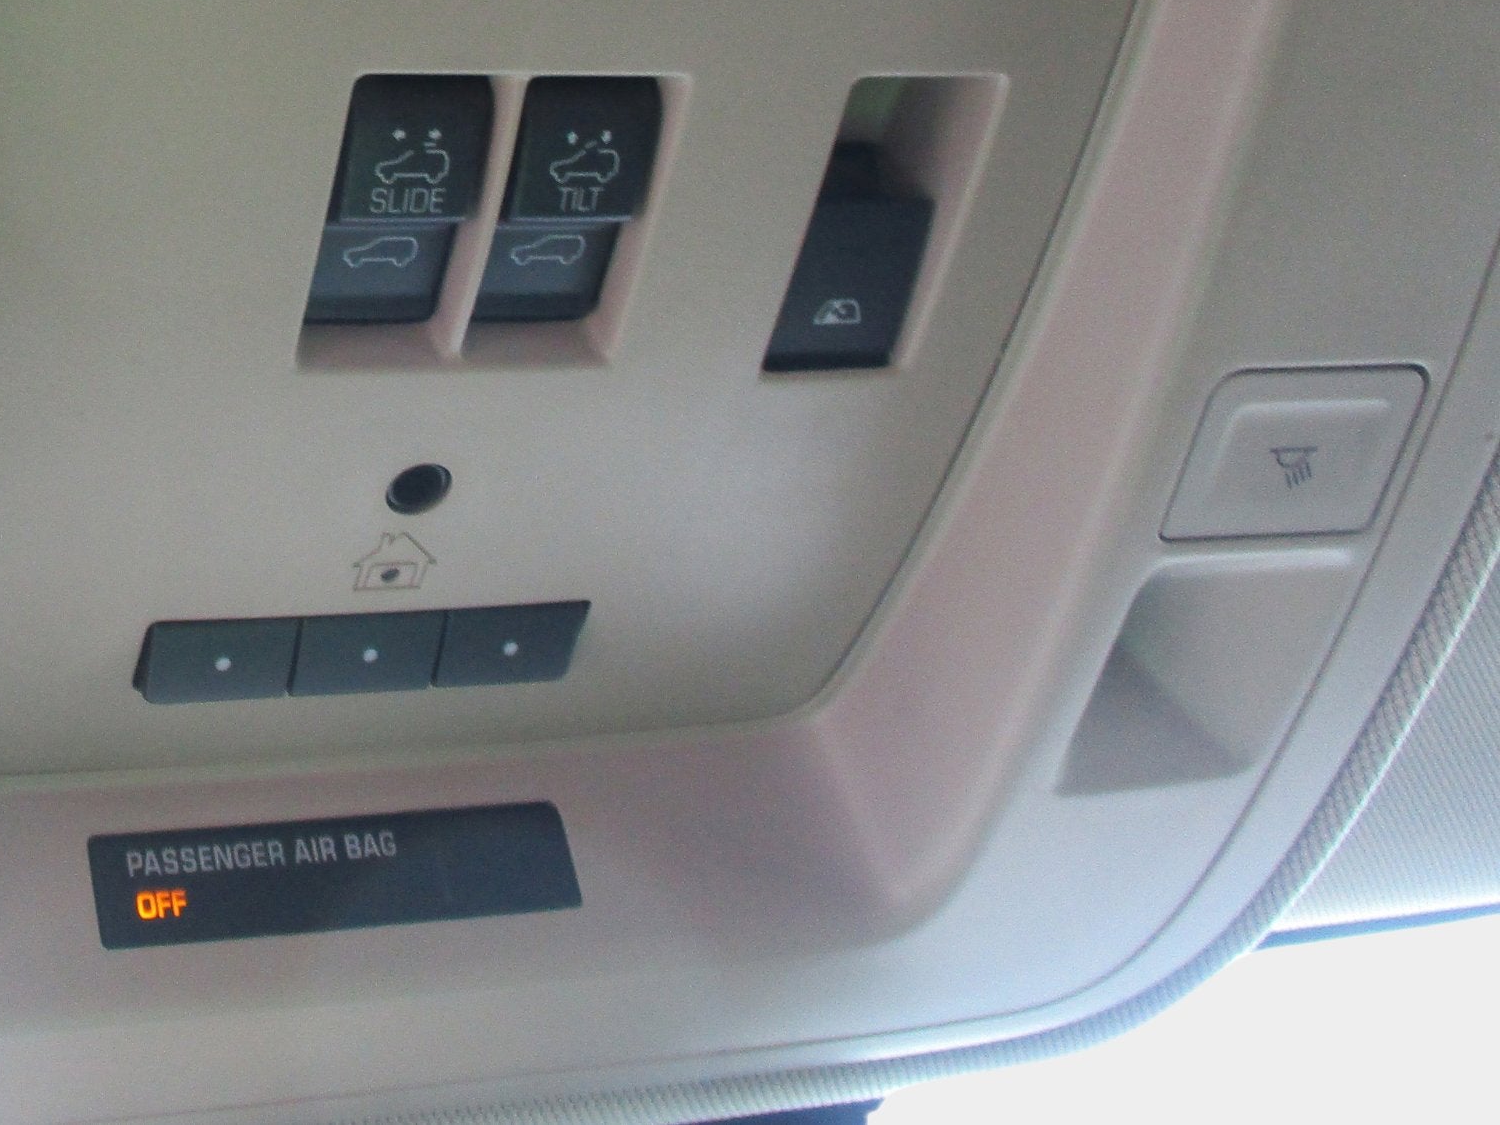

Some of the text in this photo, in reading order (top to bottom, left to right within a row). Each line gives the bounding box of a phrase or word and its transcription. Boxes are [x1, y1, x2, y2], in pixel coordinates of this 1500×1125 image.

[370, 187, 445, 213] SLIDE
[558, 186, 604, 212] TILT
[126, 830, 398, 877] PASSENGER AIR BAG
[135, 889, 187, 920] OFF
